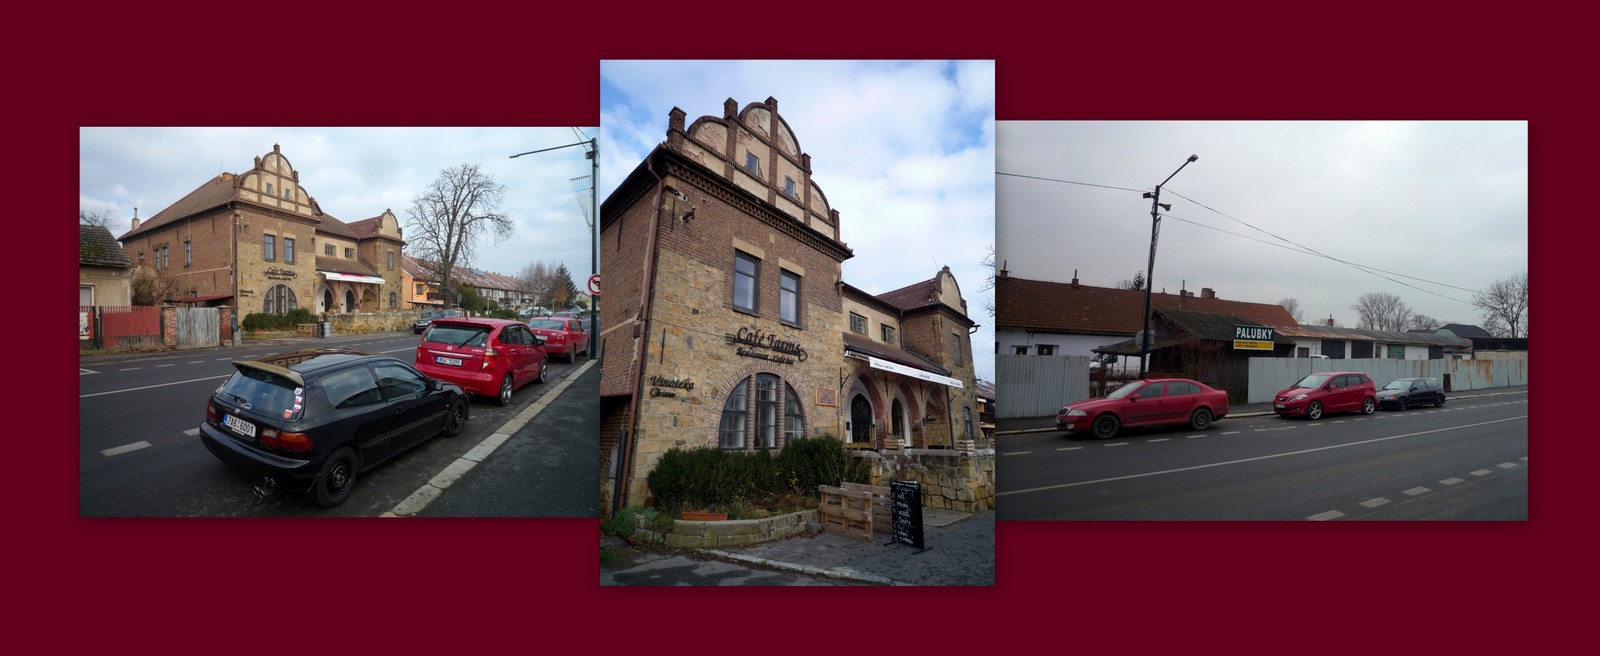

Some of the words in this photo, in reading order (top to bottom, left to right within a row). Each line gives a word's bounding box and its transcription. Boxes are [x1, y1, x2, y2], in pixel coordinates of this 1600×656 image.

[737, 327, 765, 345] Café
[767, 333, 801, 353] Farms
[1236, 327, 1273, 340] PALUBKY
